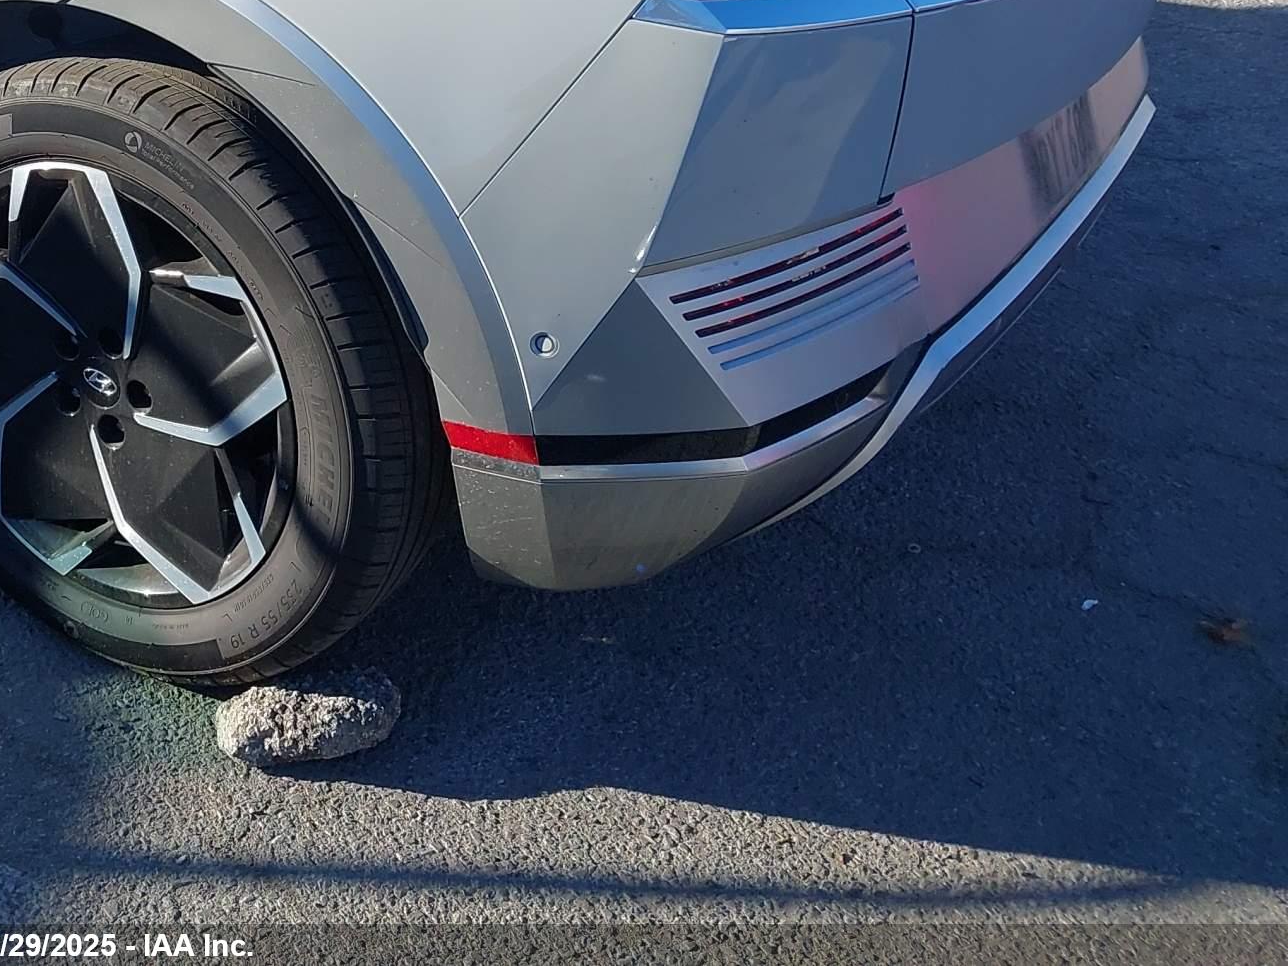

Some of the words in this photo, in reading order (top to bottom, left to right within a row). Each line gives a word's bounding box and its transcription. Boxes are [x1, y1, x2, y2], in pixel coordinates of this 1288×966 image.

[261, 579, 303, 631] 235/55
[248, 624, 260, 639] R
[230, 633, 245, 649] 19
